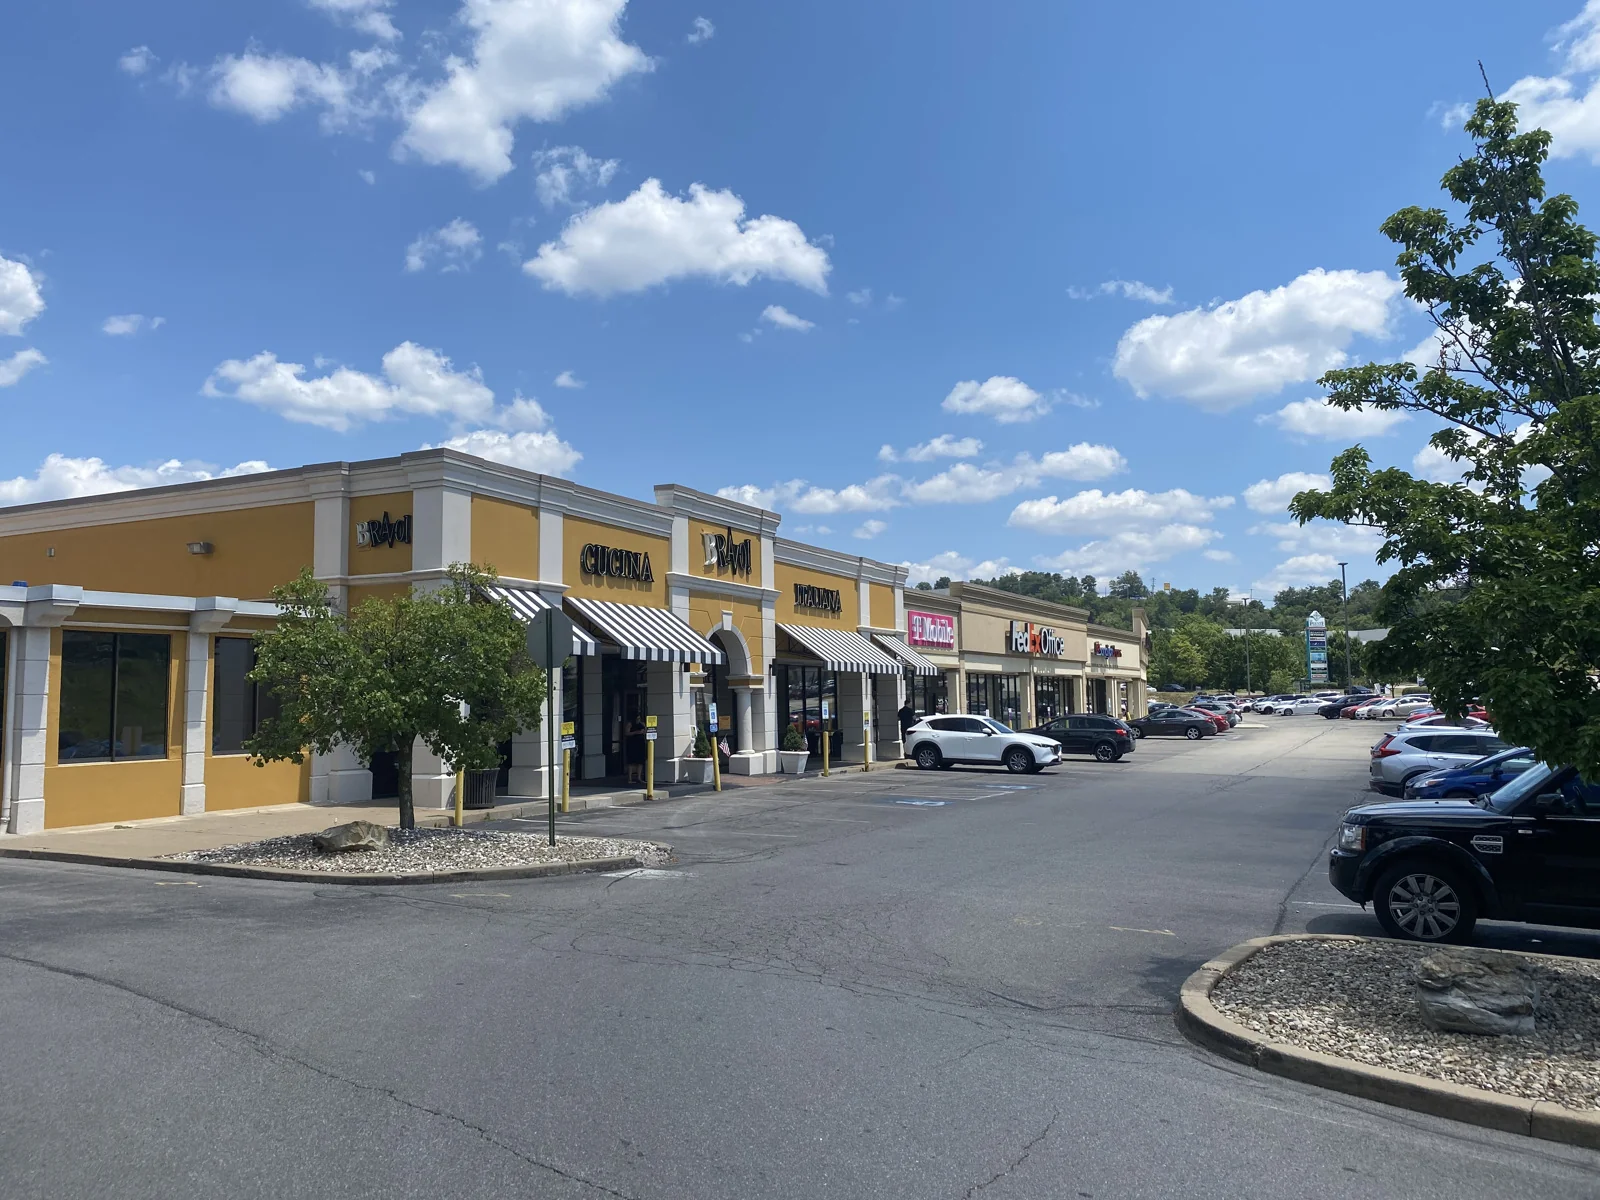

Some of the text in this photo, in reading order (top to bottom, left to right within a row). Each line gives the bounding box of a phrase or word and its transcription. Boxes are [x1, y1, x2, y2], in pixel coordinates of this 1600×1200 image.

[581, 543, 655, 582] CUCINA
[794, 583, 842, 613] ITALIANA
[1010, 620, 1041, 652] FedEx
[1040, 627, 1065, 655] Office
